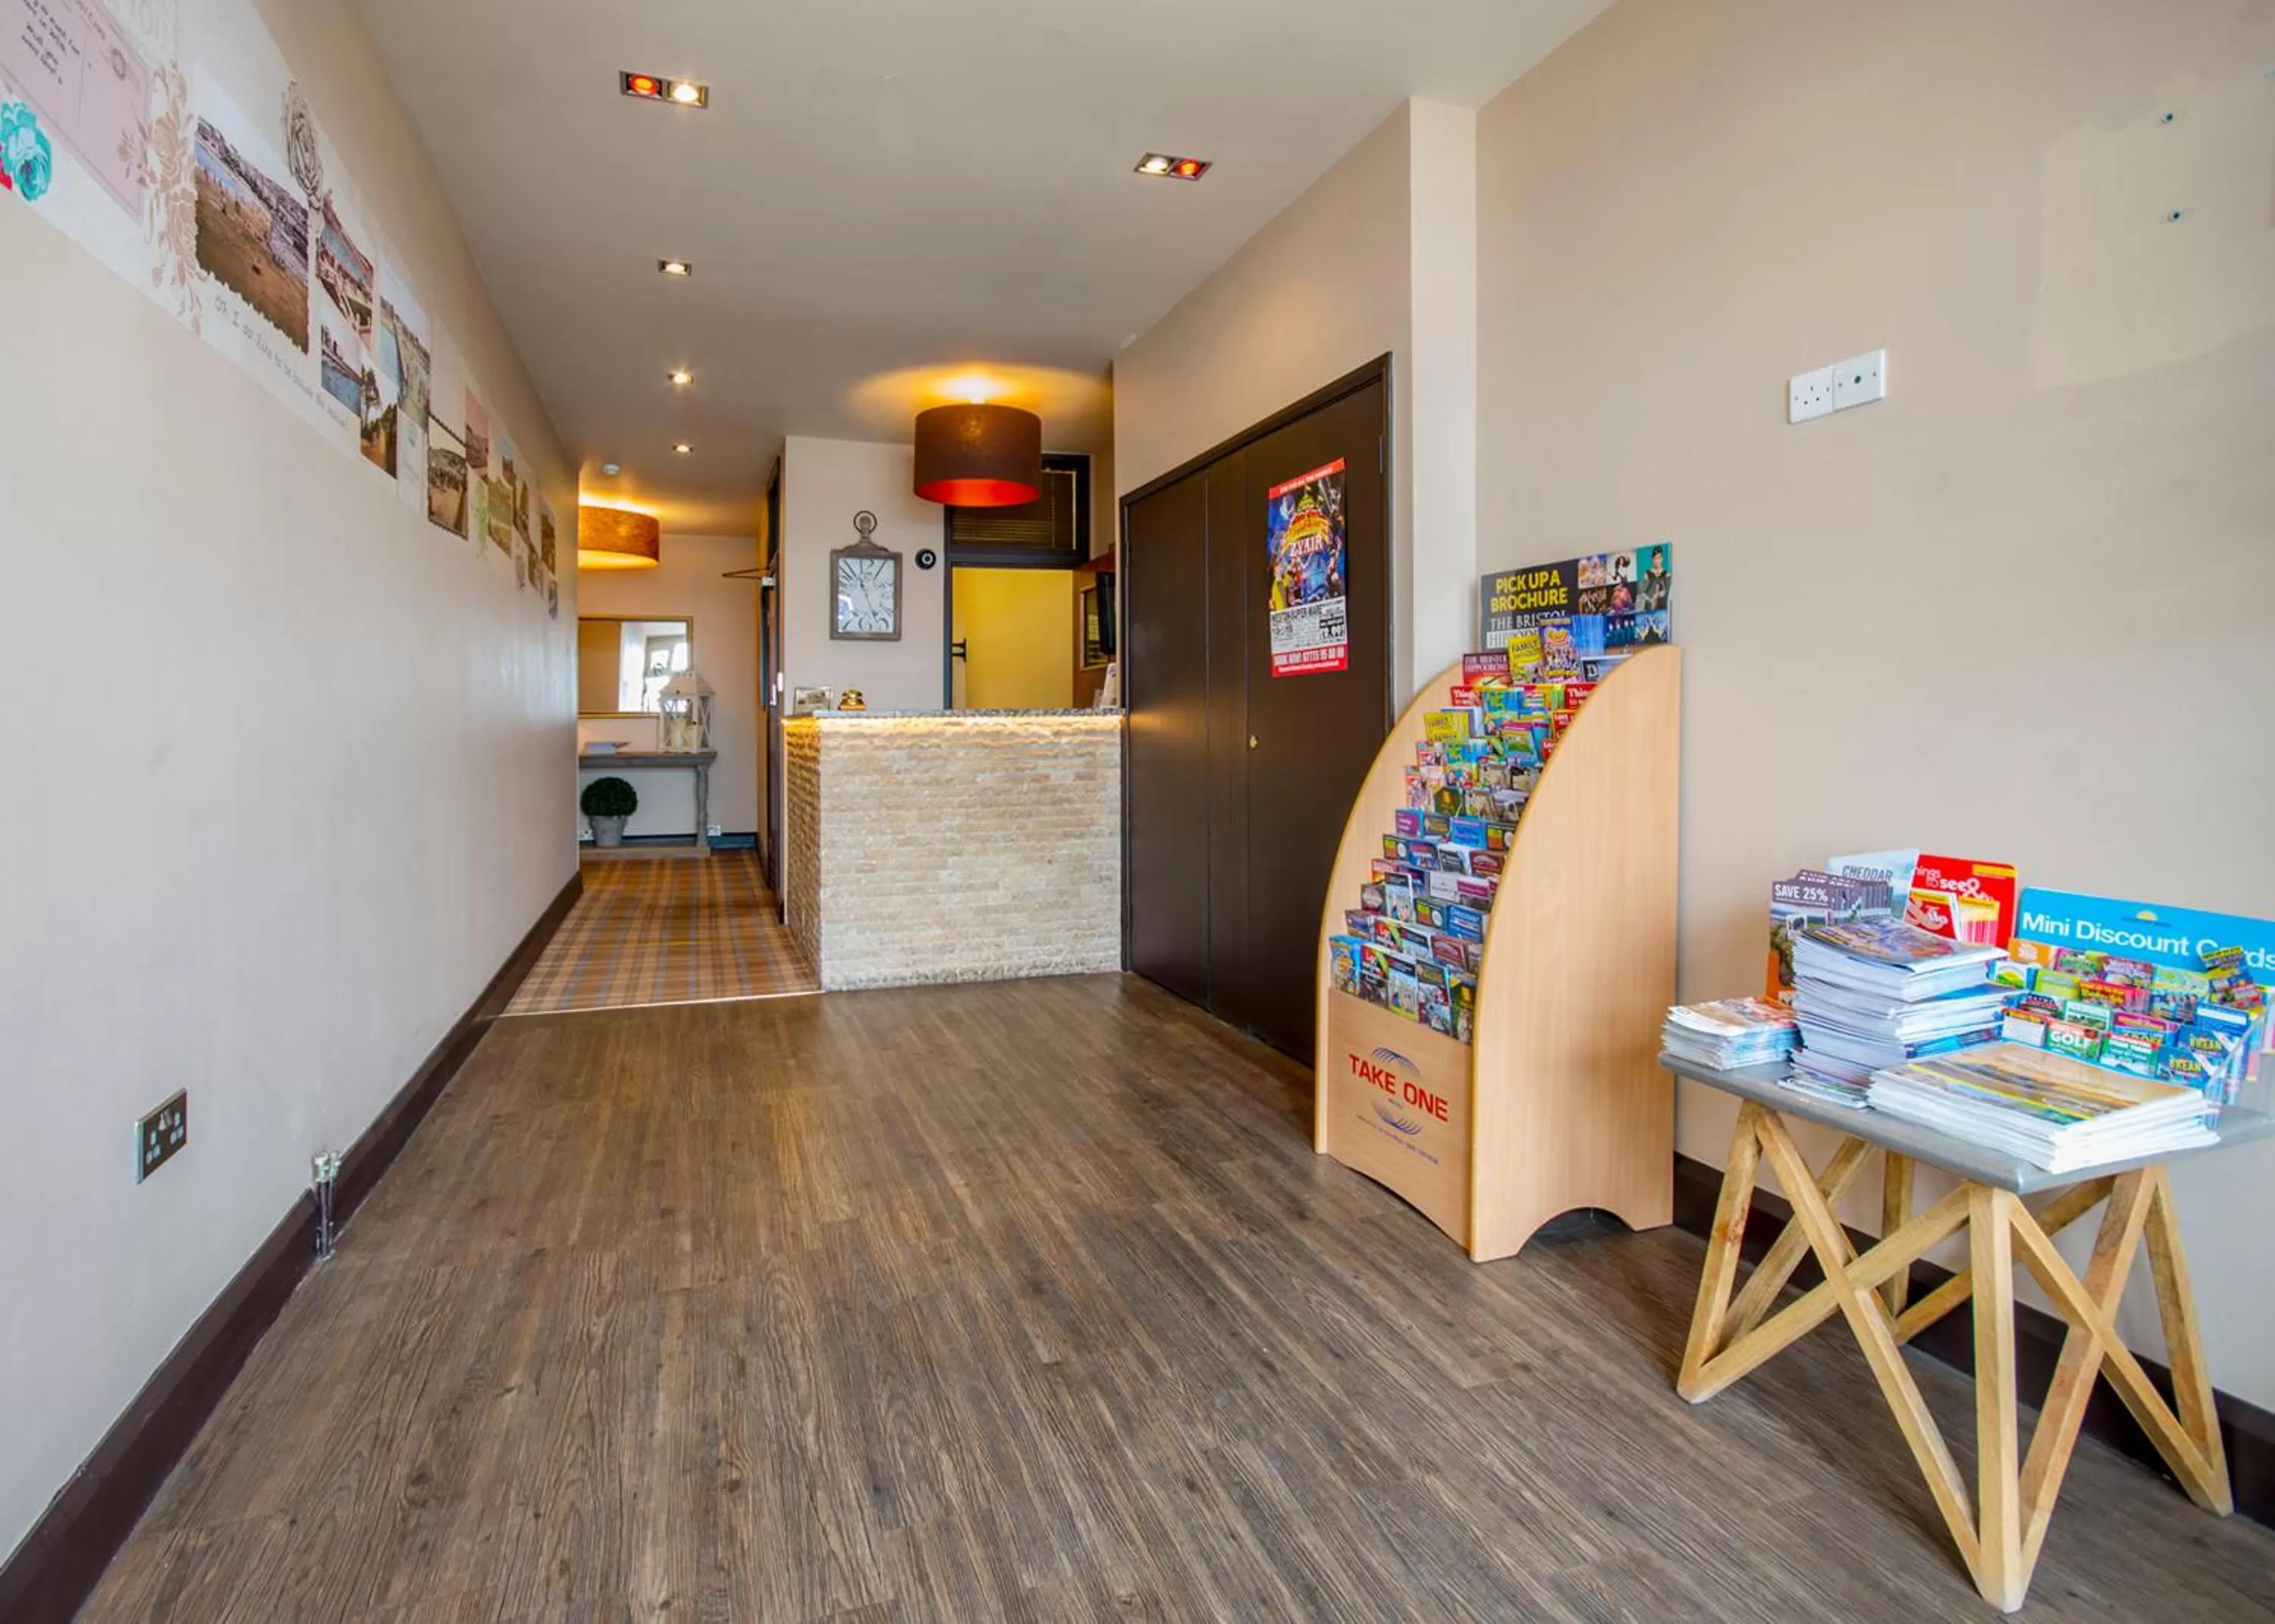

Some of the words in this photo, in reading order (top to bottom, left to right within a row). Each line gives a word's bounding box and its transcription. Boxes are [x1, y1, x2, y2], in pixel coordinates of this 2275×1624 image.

[1495, 574, 1527, 594] PICK
[1528, 571, 1549, 589] UP
[1549, 569, 1561, 587] A
[1490, 586, 1568, 613] BROCHURE
[1490, 616, 1513, 631] THE
[1842, 864, 1894, 882] CHEDDAR
[1774, 883, 1800, 898] SAVE
[1803, 886, 1828, 901] 25%
[2022, 912, 2069, 937] Mini
[2076, 920, 2189, 956] Discount
[1349, 1053, 1396, 1096] TAKE
[1404, 1081, 1449, 1123] ONE
